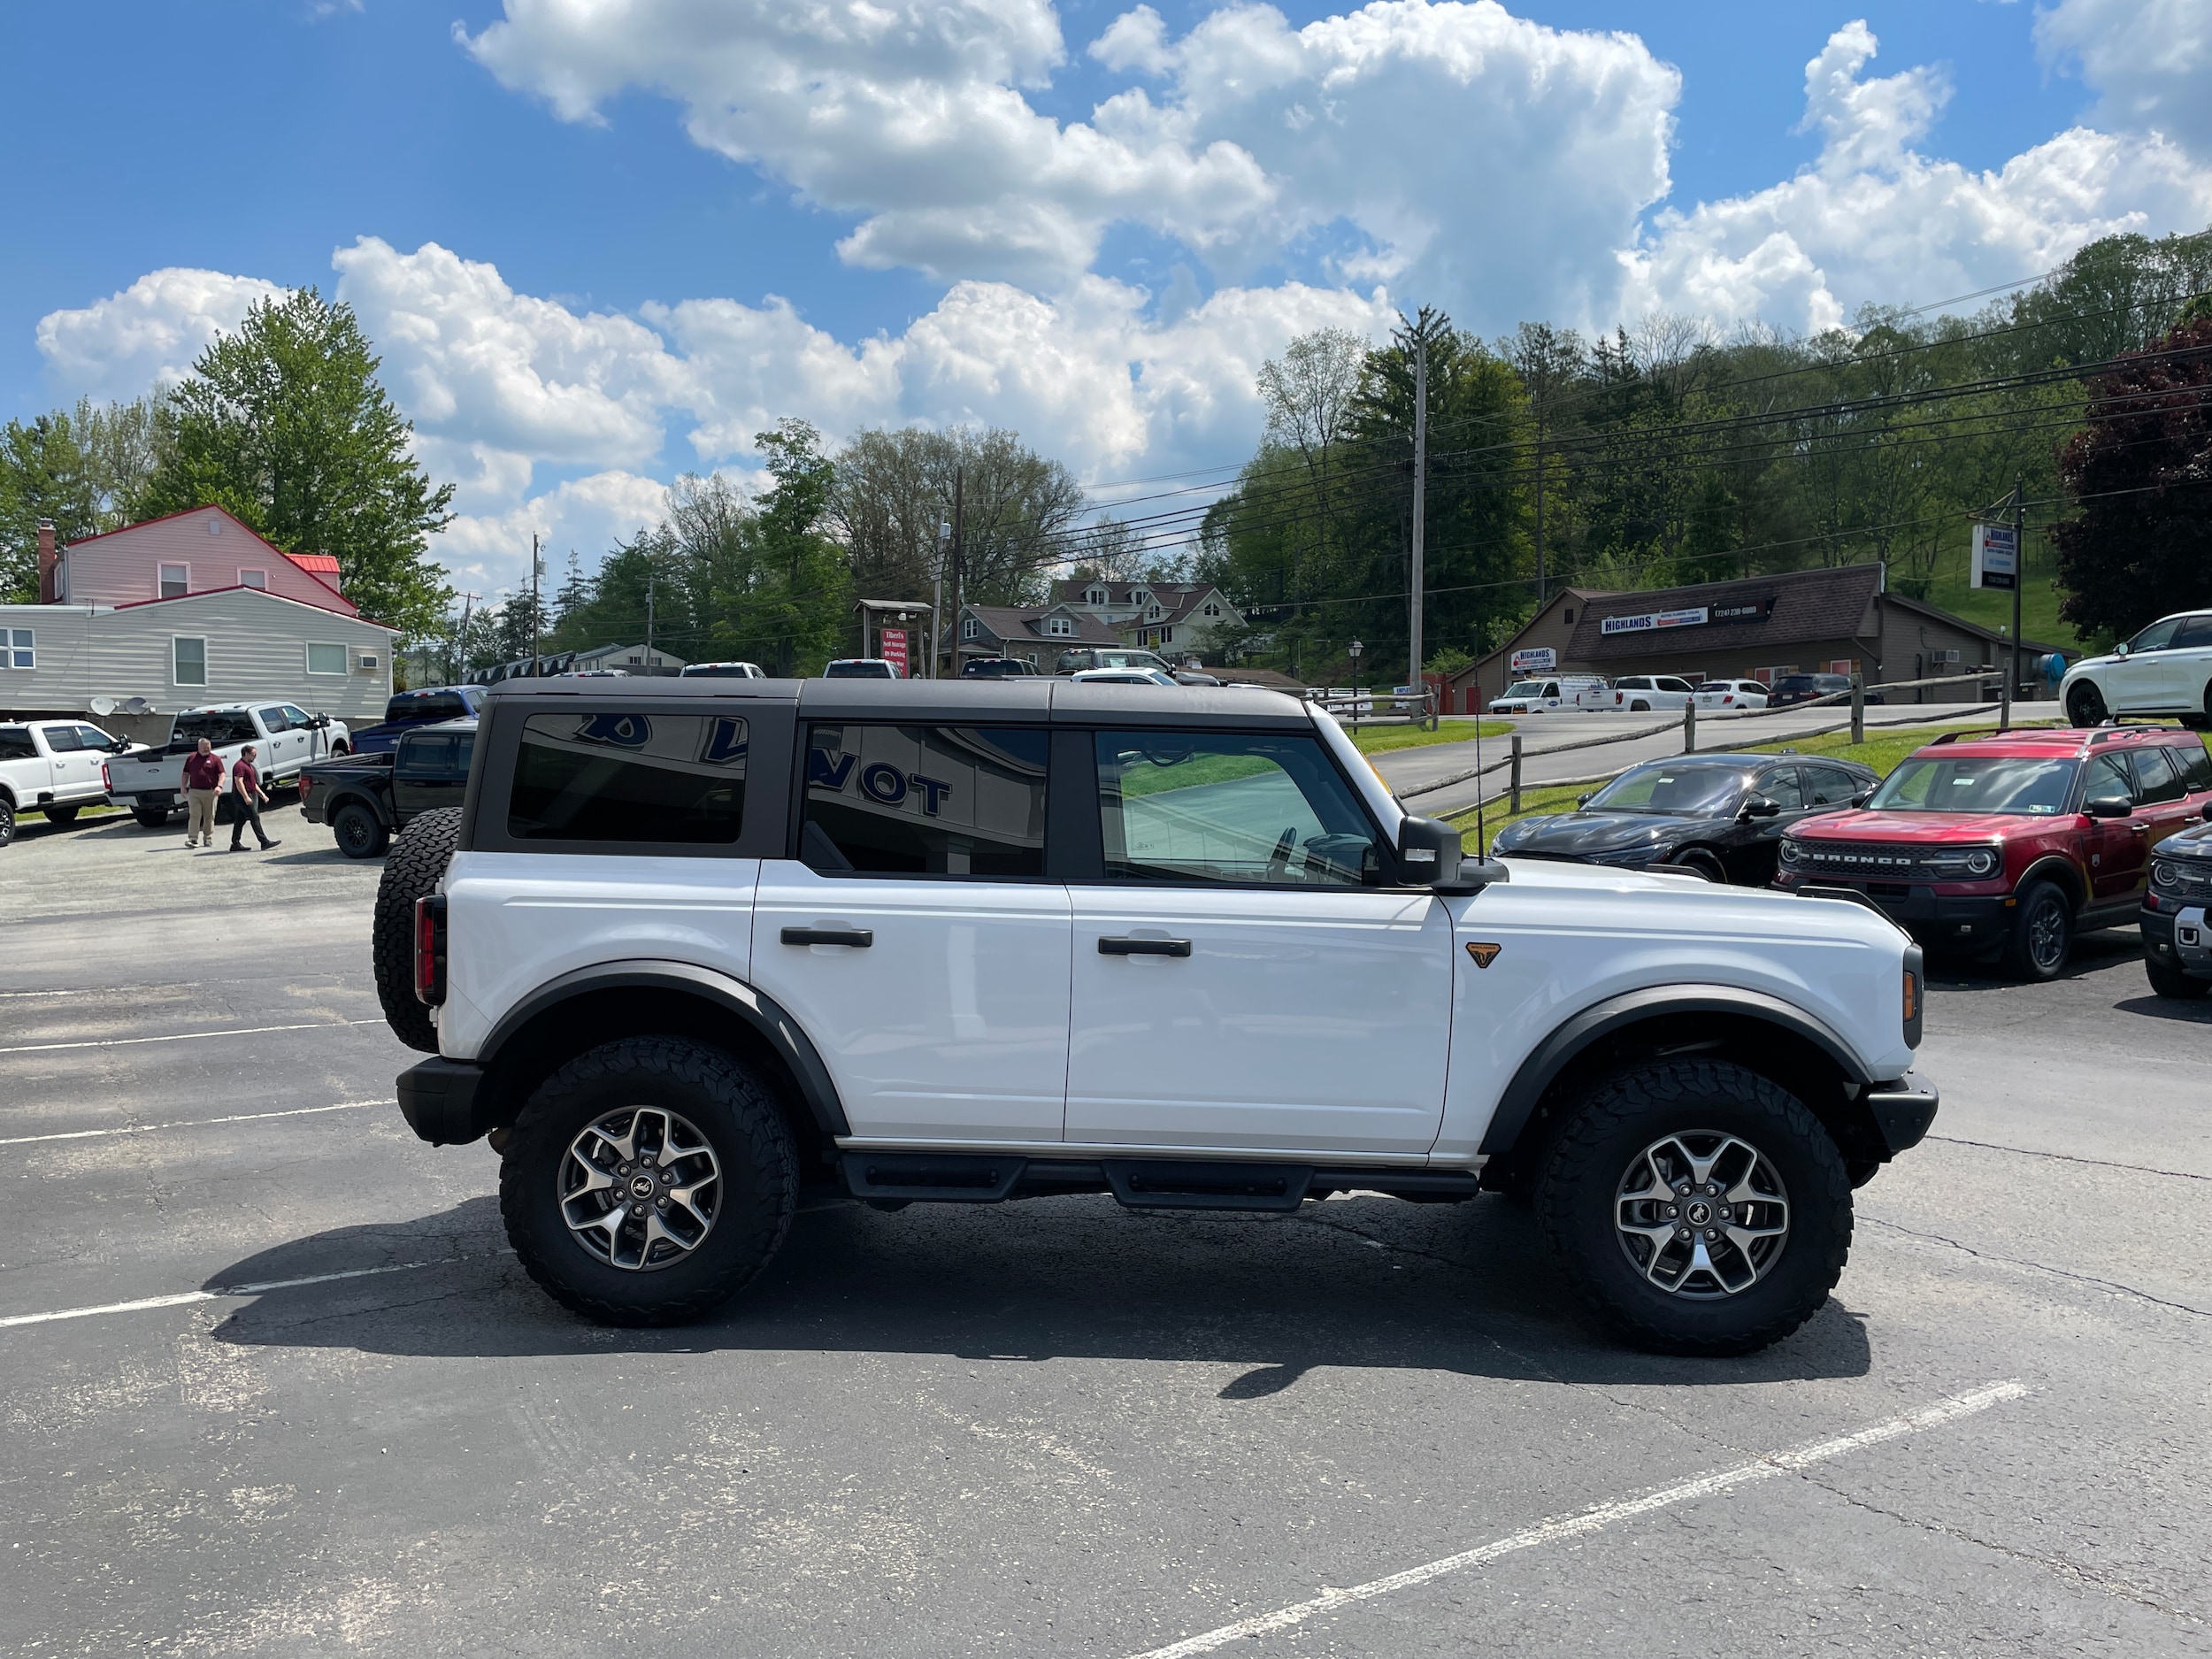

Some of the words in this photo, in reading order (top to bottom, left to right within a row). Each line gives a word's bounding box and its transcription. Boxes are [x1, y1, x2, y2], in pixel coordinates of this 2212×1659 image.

[1605, 616, 1651, 632] HIGHLANDS
[1520, 649, 1550, 660] HIGHLANDS
[1813, 854, 1911, 865] BRONCO
